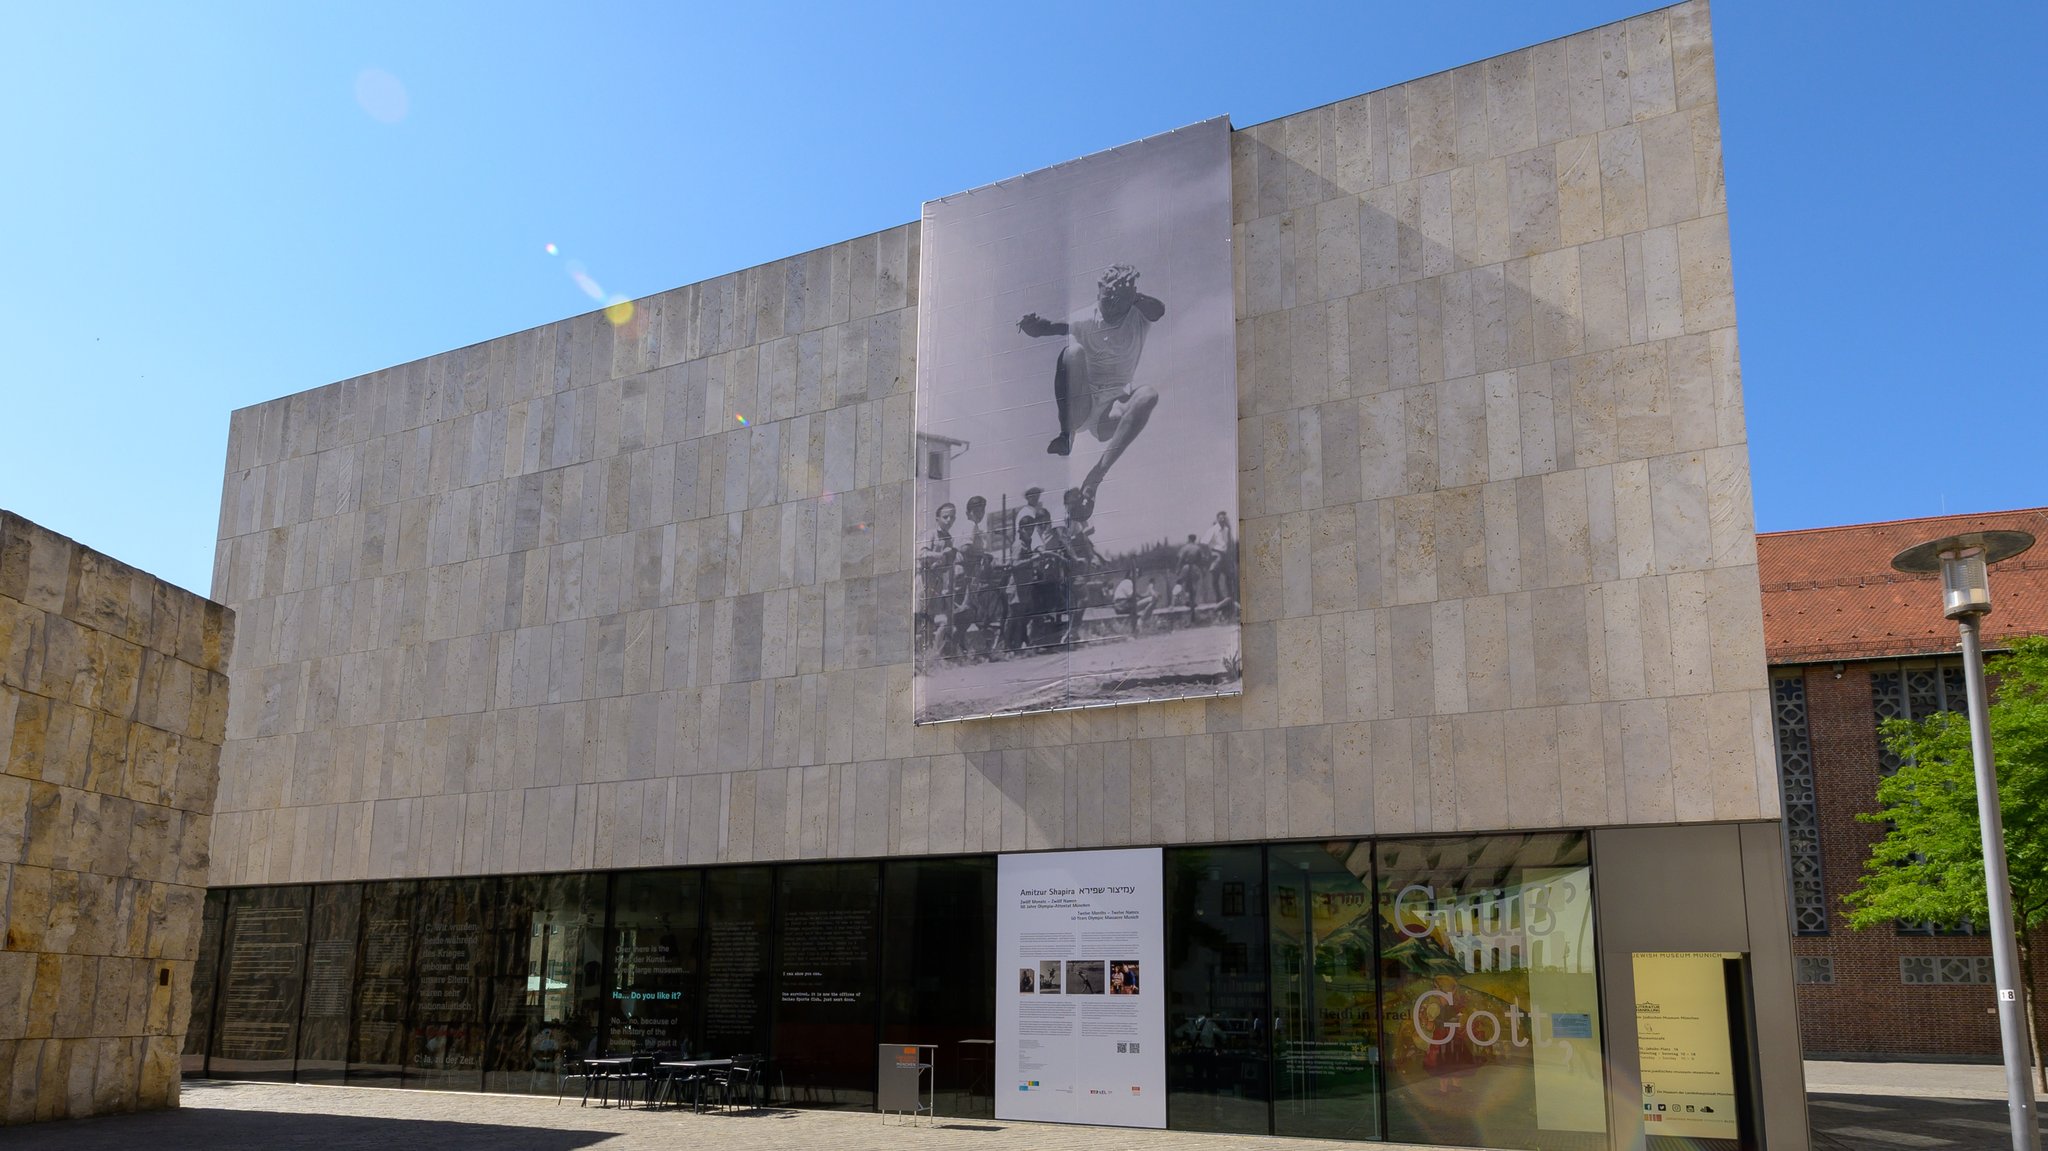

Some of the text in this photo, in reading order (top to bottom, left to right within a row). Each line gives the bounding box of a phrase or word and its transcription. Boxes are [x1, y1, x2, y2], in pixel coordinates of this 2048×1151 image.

[1049, 888, 1075, 897] Shapira
[1079, 887, 1105, 895] שפירא
[634, 967, 652, 975] large
[631, 991, 641, 999] Do
[642, 992, 656, 1001] you
[656, 991, 670, 999] like
[671, 991, 682, 999] it?
[1358, 1007, 1370, 1019] in
[640, 1017, 669, 1025] because
[670, 1017, 678, 1025] of
[610, 1027, 666, 1036] the history of the
[445, 1055, 457, 1064] der
